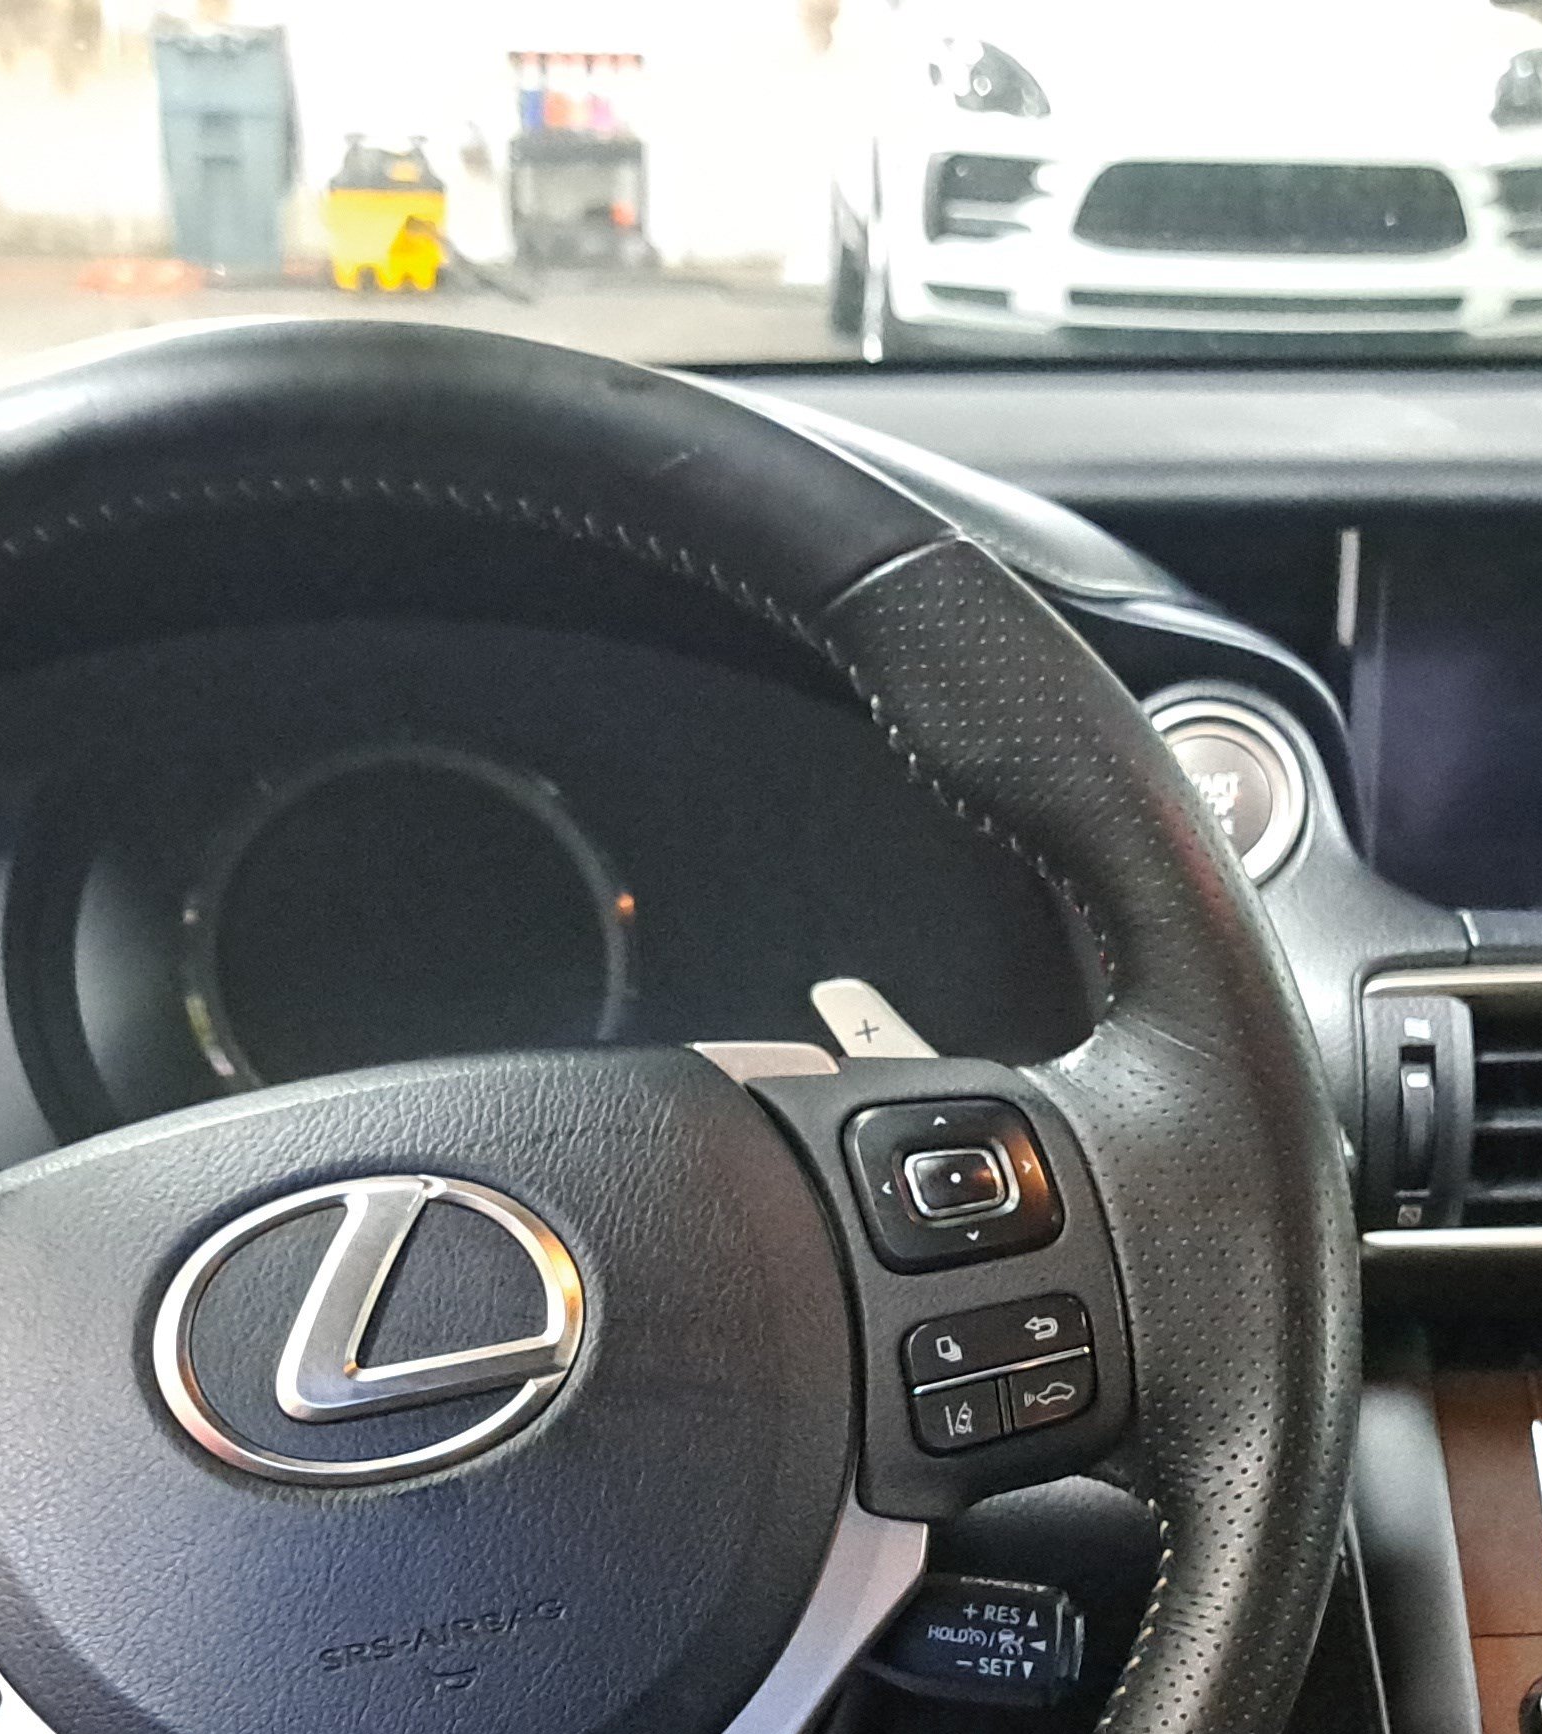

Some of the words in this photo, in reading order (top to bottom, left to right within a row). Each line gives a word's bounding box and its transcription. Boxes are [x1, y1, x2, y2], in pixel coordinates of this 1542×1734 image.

[982, 1604, 1021, 1625] RES
[927, 1623, 967, 1645] HOLD
[977, 1656, 1016, 1678] SET
